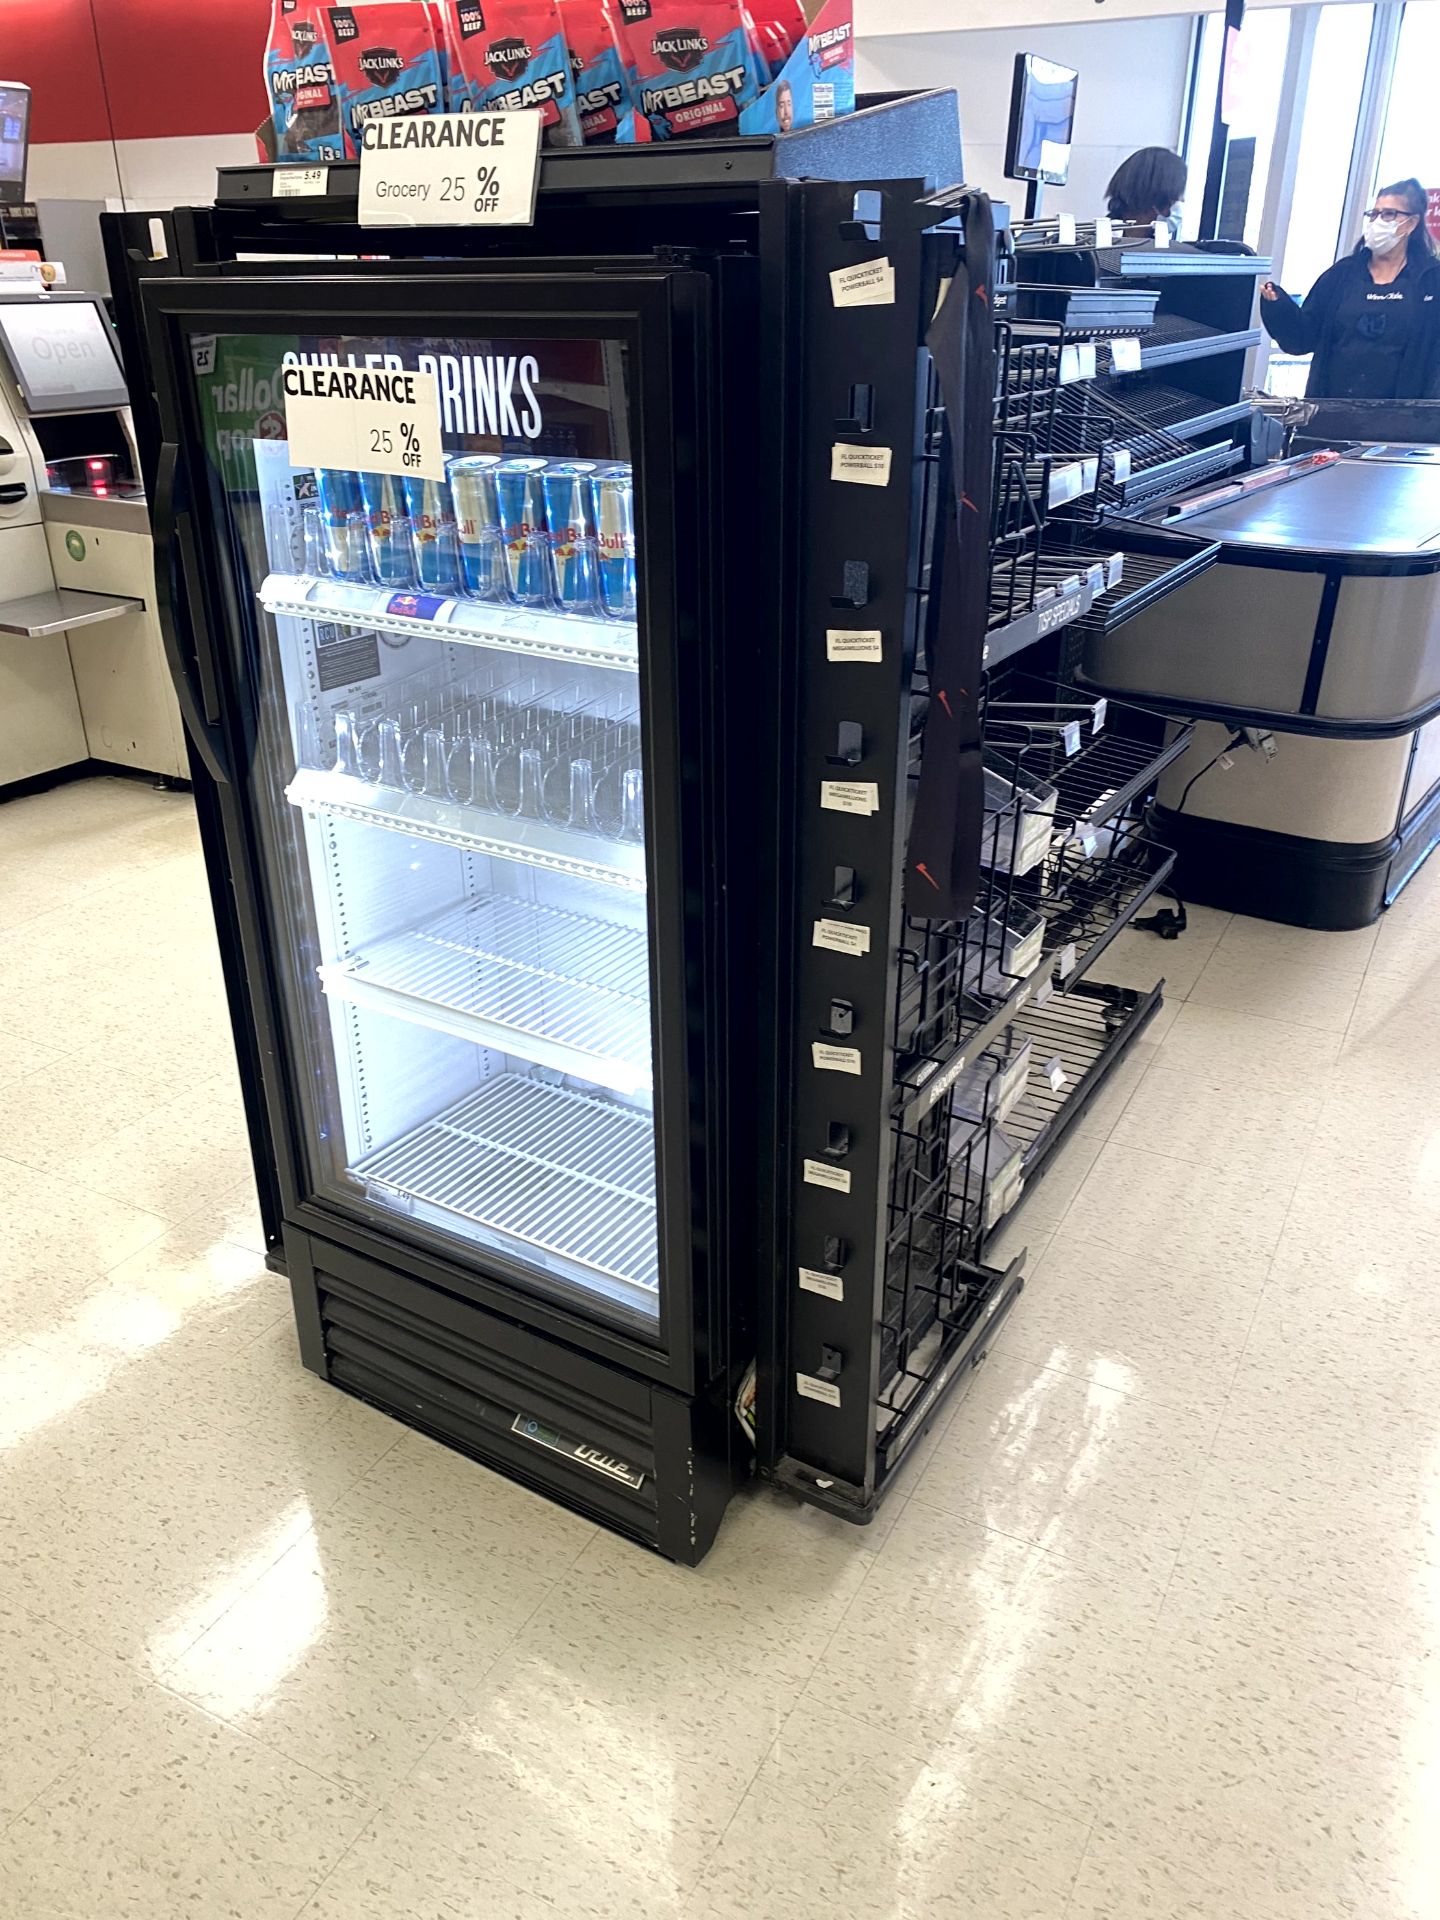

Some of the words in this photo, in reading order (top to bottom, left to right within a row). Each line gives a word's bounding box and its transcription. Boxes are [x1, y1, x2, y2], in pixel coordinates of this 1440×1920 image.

[461, 11, 482, 23] 100%
[625, 7, 647, 16] BEEF
[463, 21, 482, 32] BEEF
[652, 40, 678, 54] JACK
[484, 50, 507, 65] JACK
[675, 101, 726, 123] ORIGINAL
[363, 118, 505, 150] CLEARANCE
[304, 170, 321, 180] 5.49
[376, 180, 431, 201] Grocery
[440, 177, 465, 201] 25
[477, 166, 500, 196] %
[474, 197, 500, 212] OFF
[32, 337, 97, 364] Open
[284, 369, 416, 404] CLEARANCE
[370, 429, 393, 453] 25
[400, 422, 420, 452] %
[402, 452, 422, 468] OFF
[599, 532, 625, 549] Bull
